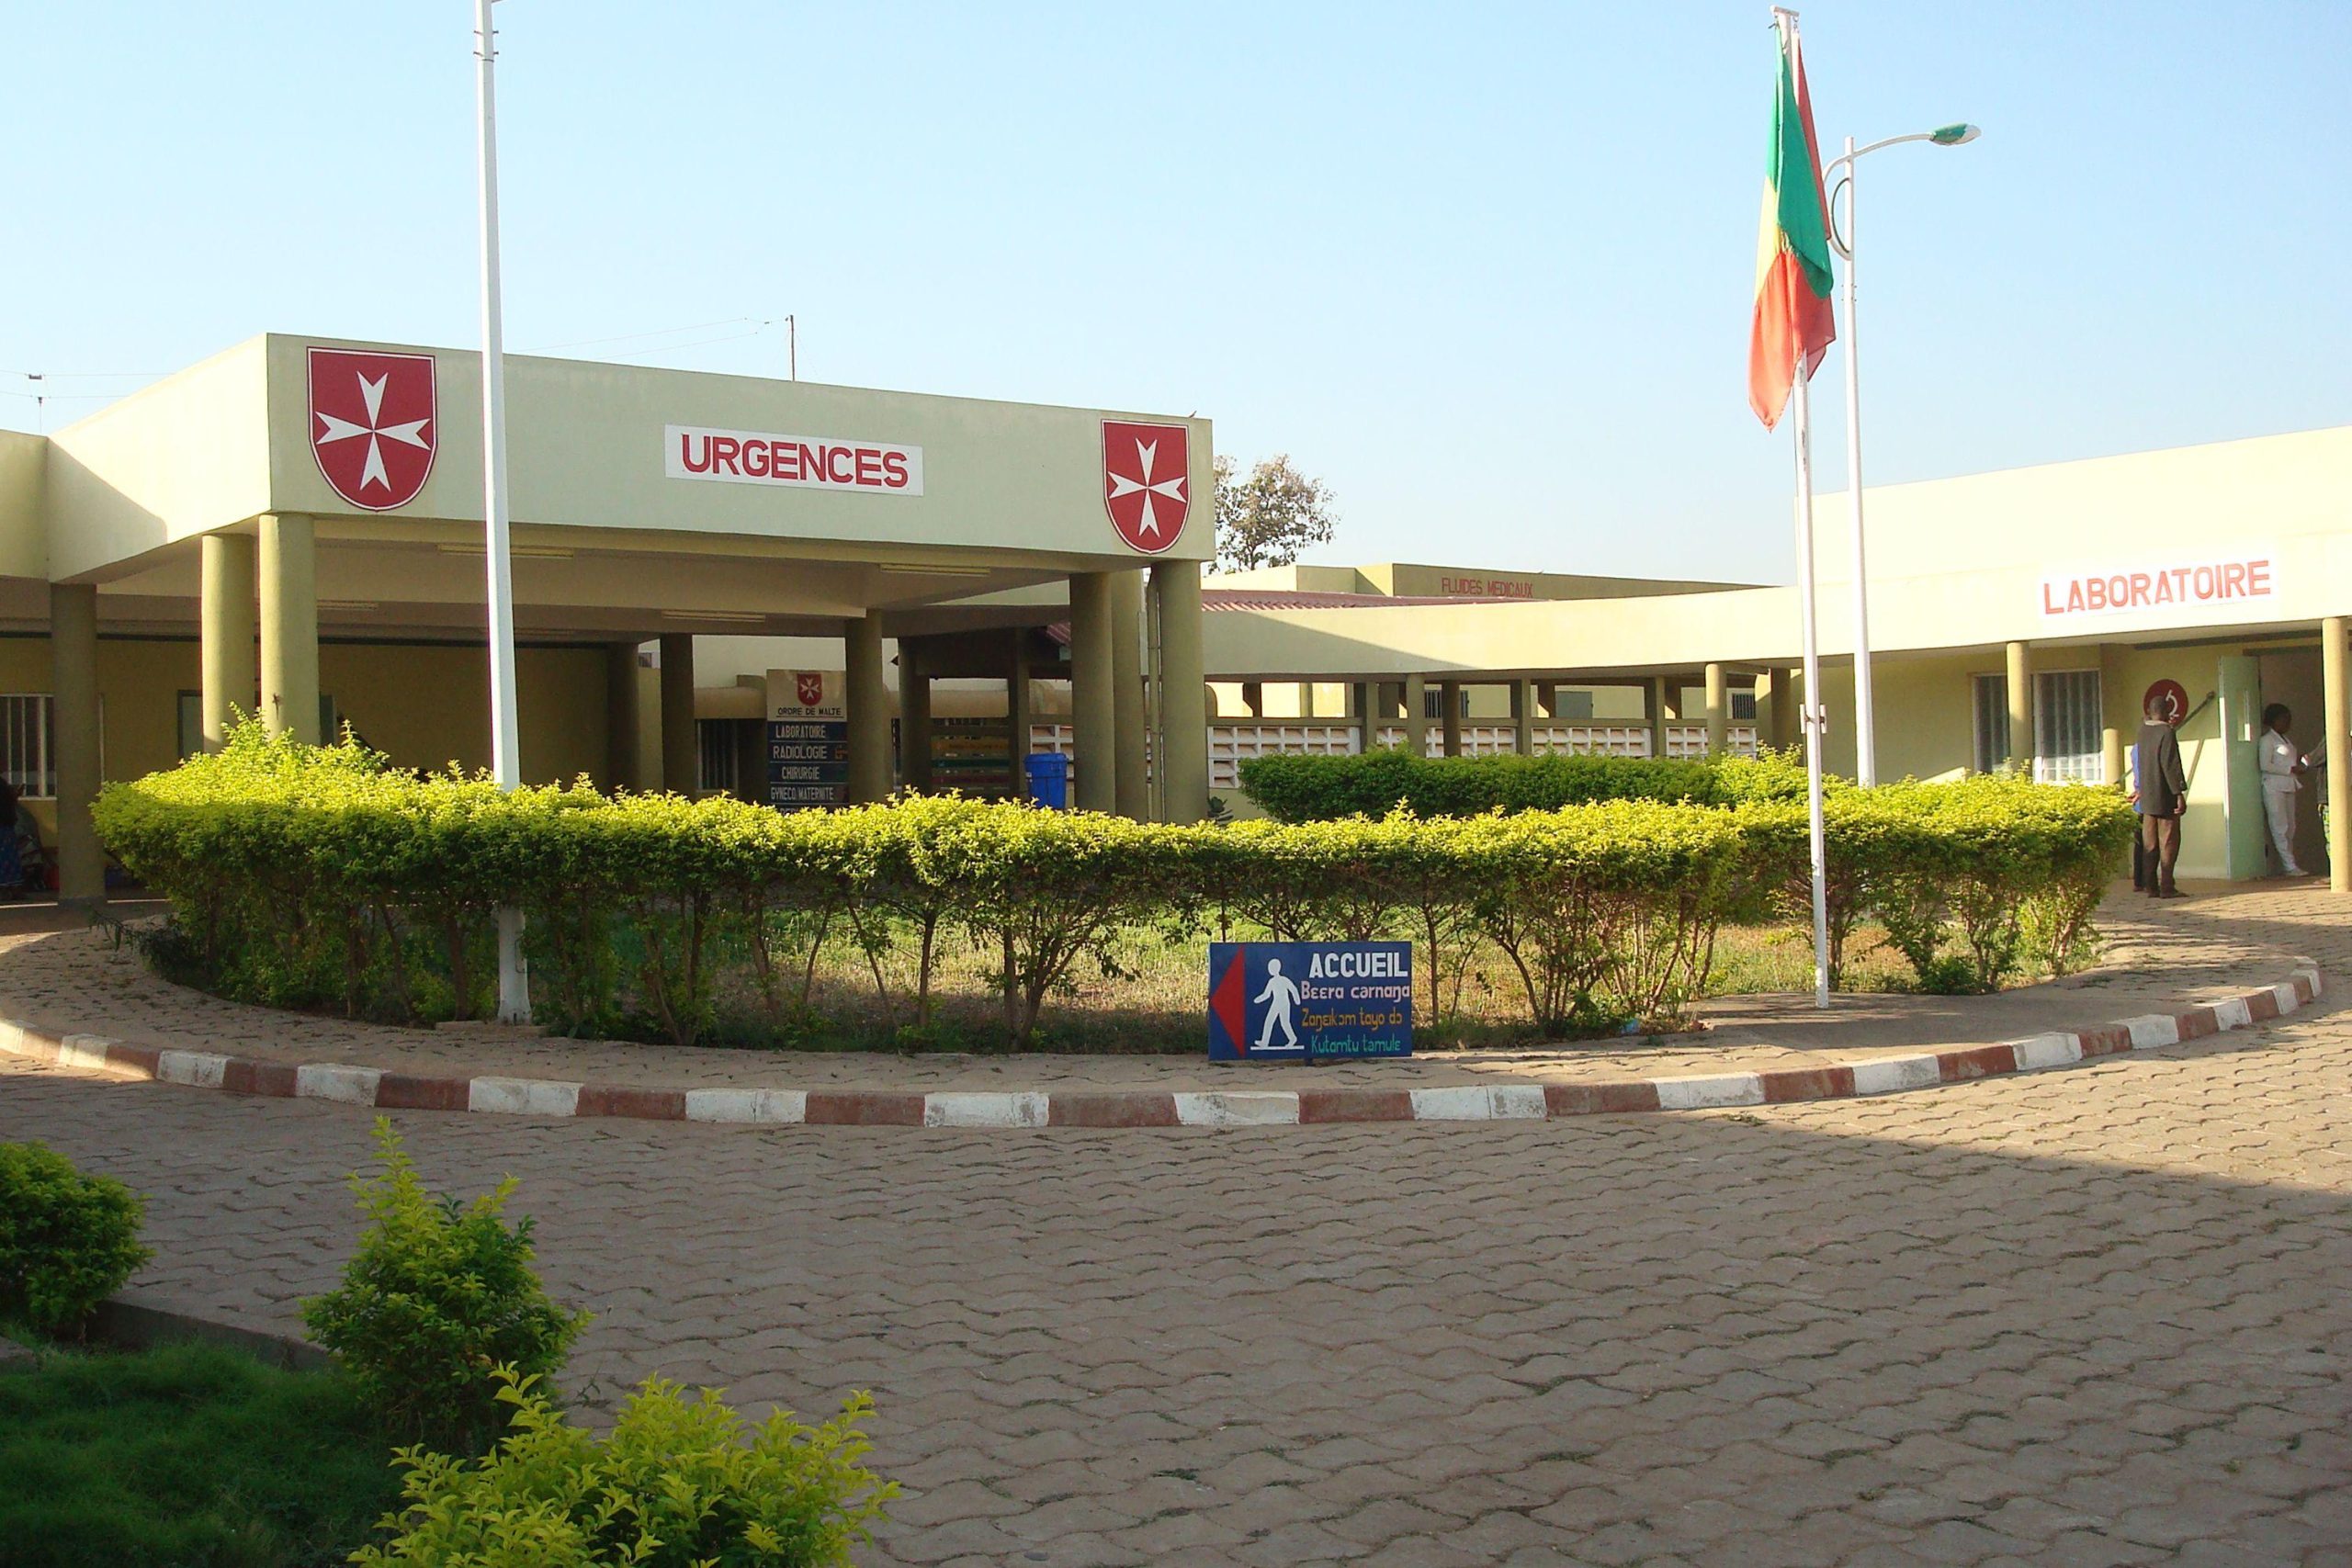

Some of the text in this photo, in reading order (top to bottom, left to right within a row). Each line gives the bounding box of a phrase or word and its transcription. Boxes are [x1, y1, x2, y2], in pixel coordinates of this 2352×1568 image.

[681, 433, 909, 488] URGENCES
[1441, 577, 1533, 598] FLUIDES MEDICAUX
[2043, 560, 2271, 615] LABORATOIRE
[778, 707, 842, 716] ORDRE DE MALTE
[775, 725, 827, 739] LABORATOIRE
[773, 746, 828, 760] RADIOLOGIE
[782, 766, 820, 780] CHIRURGIE
[1308, 952, 1408, 978] ACCUEIL
